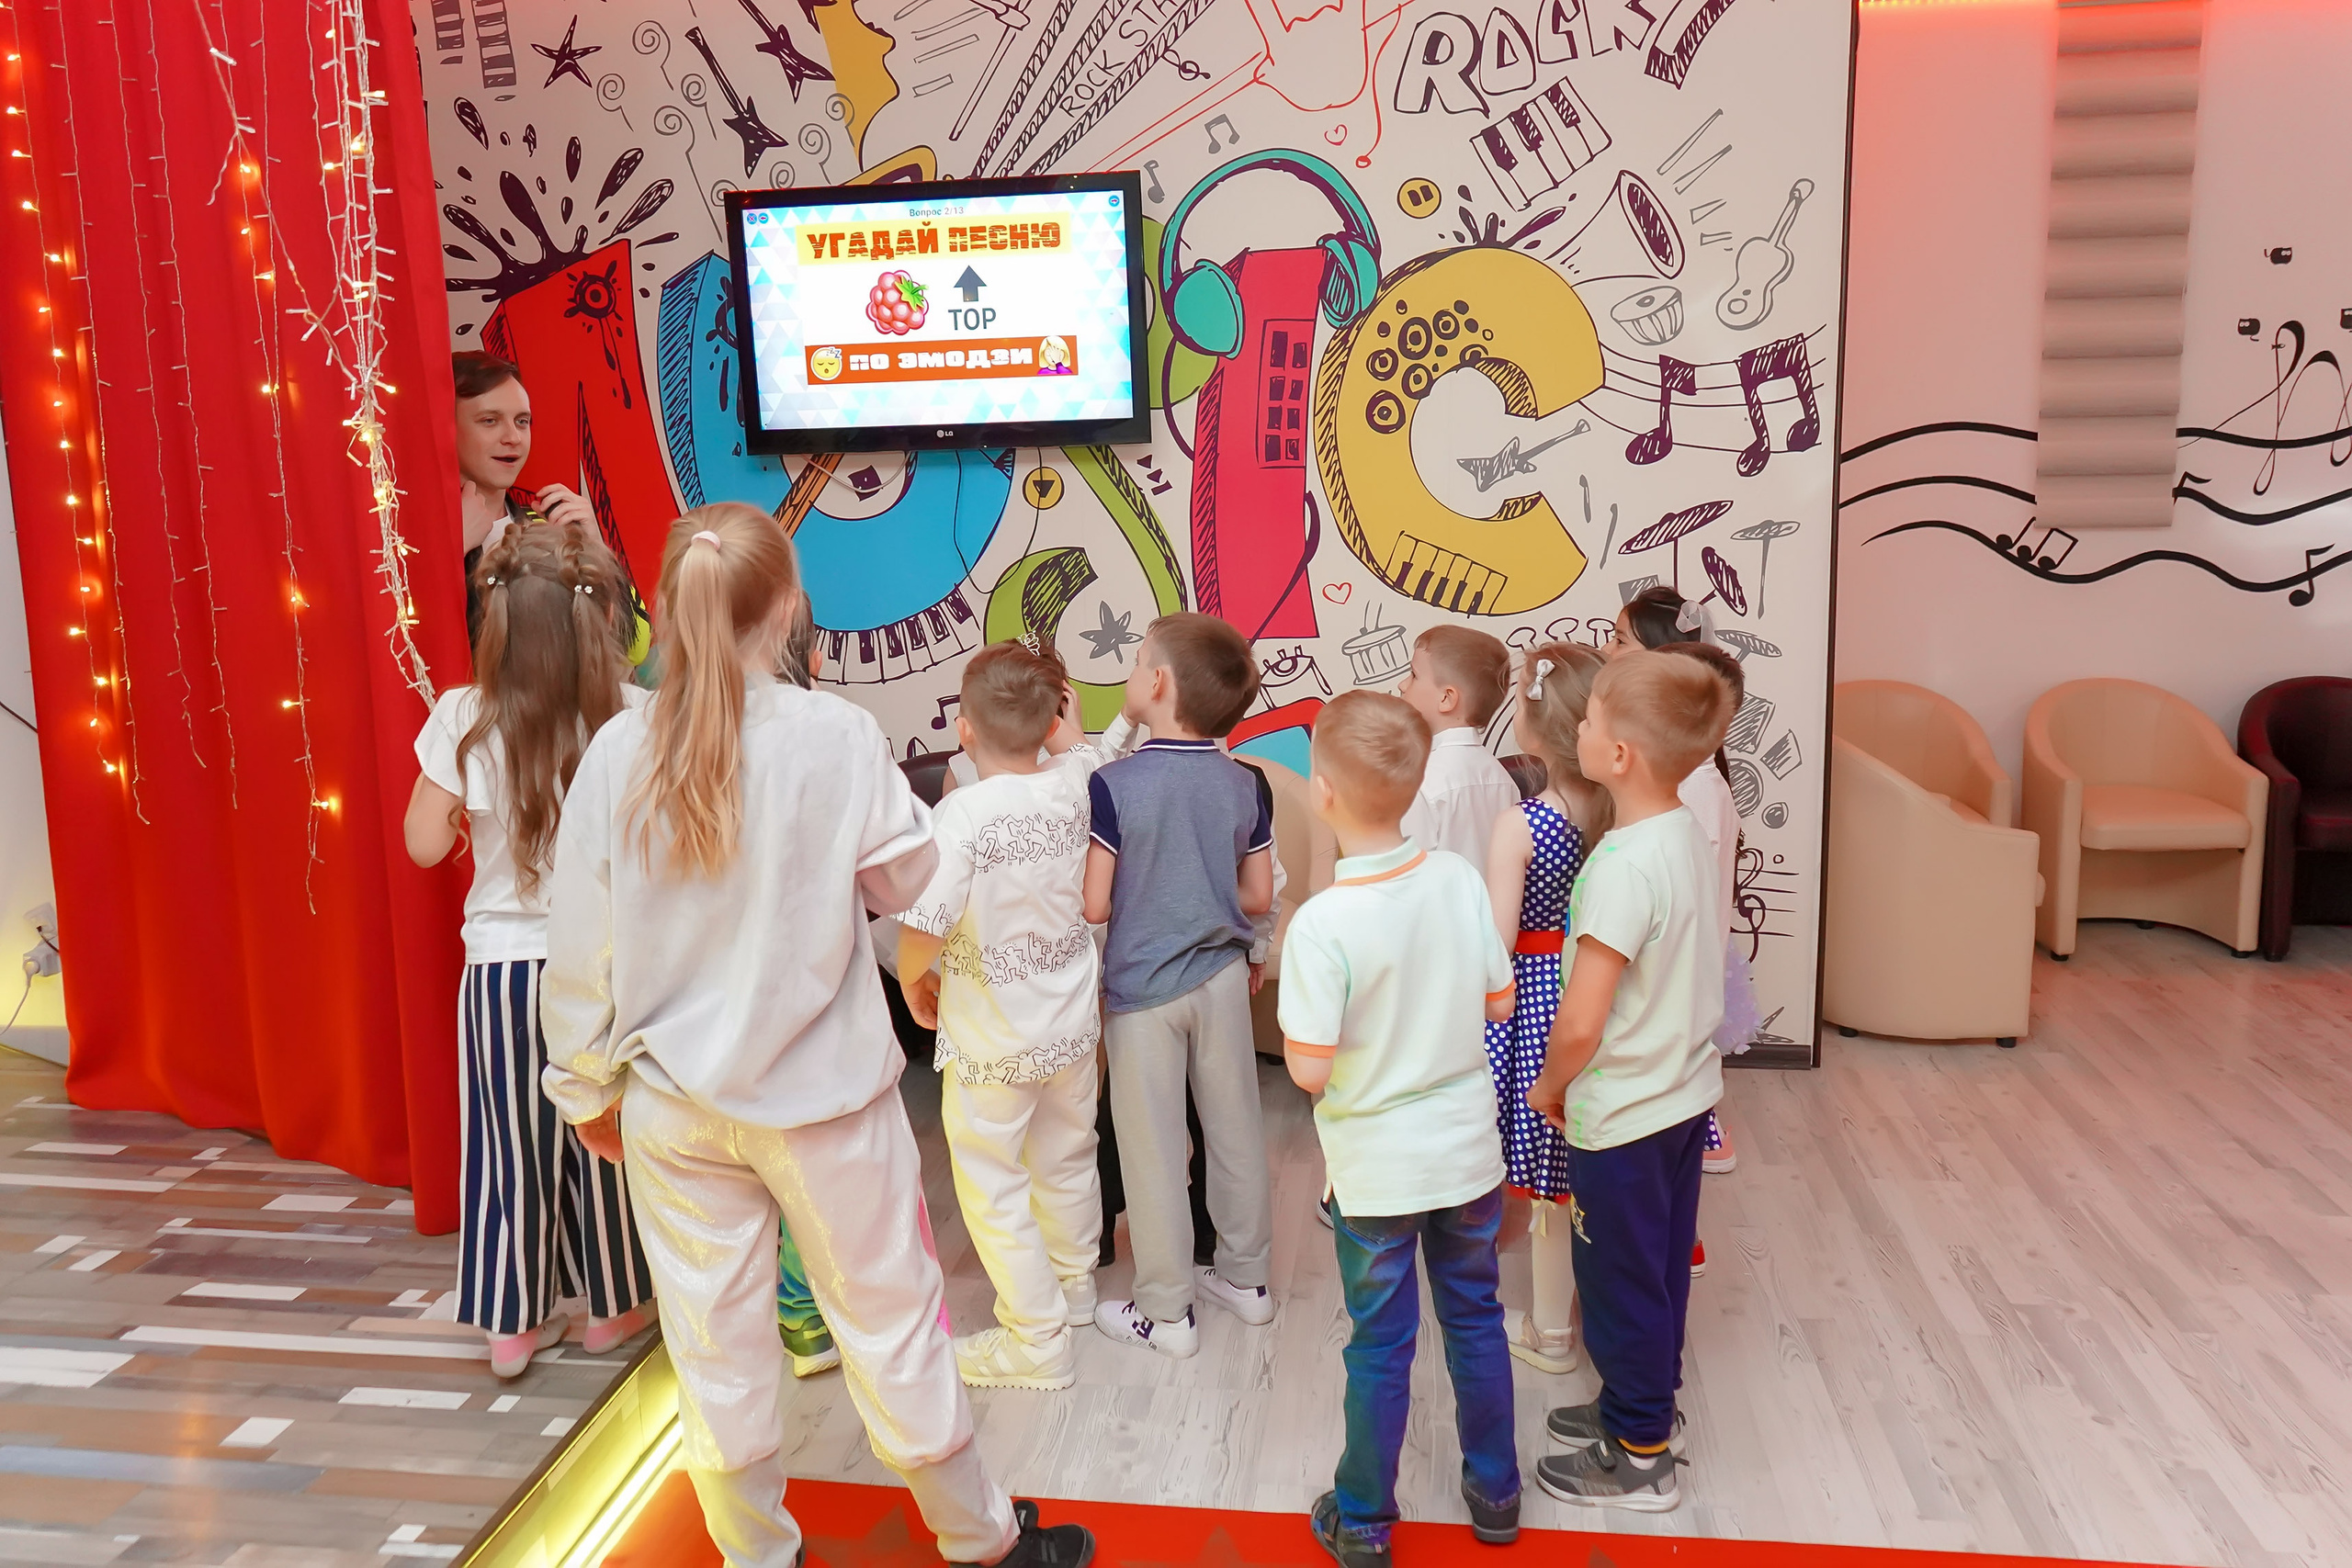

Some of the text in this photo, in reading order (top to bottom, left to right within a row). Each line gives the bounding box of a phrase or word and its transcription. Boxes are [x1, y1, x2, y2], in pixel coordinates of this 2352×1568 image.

[1059, 50, 1126, 118] ROCK
[910, 206, 964, 218] Вопрос 2/13
[807, 221, 1060, 260] УГАДАЙ ПЕСНЮ
